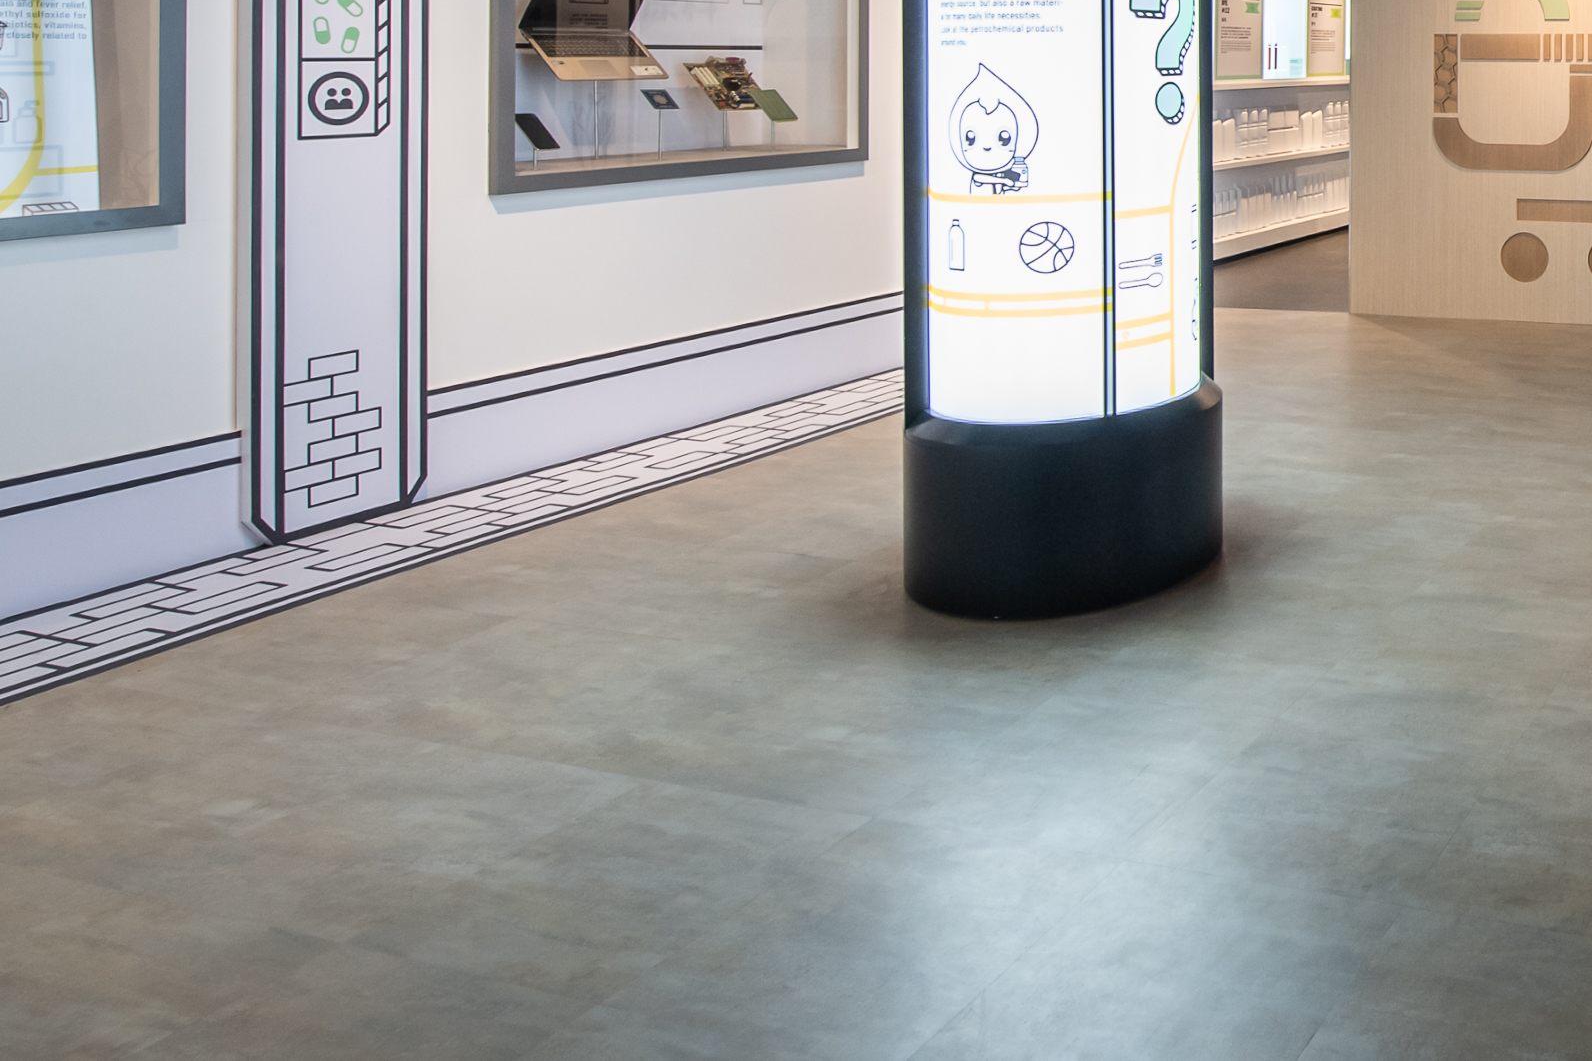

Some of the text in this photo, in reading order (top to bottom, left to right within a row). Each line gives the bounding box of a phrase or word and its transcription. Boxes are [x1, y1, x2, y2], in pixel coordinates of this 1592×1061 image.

[36, 0, 59, 8] fever
[1015, 0, 1032, 7] raw
[26, 10, 70, 19] sulfoxide
[74, 11, 87, 19] for
[970, 25, 1024, 35] petrochemical
[1025, 24, 1064, 34] products
[6, 31, 39, 41] closely
[42, 32, 75, 40] related
